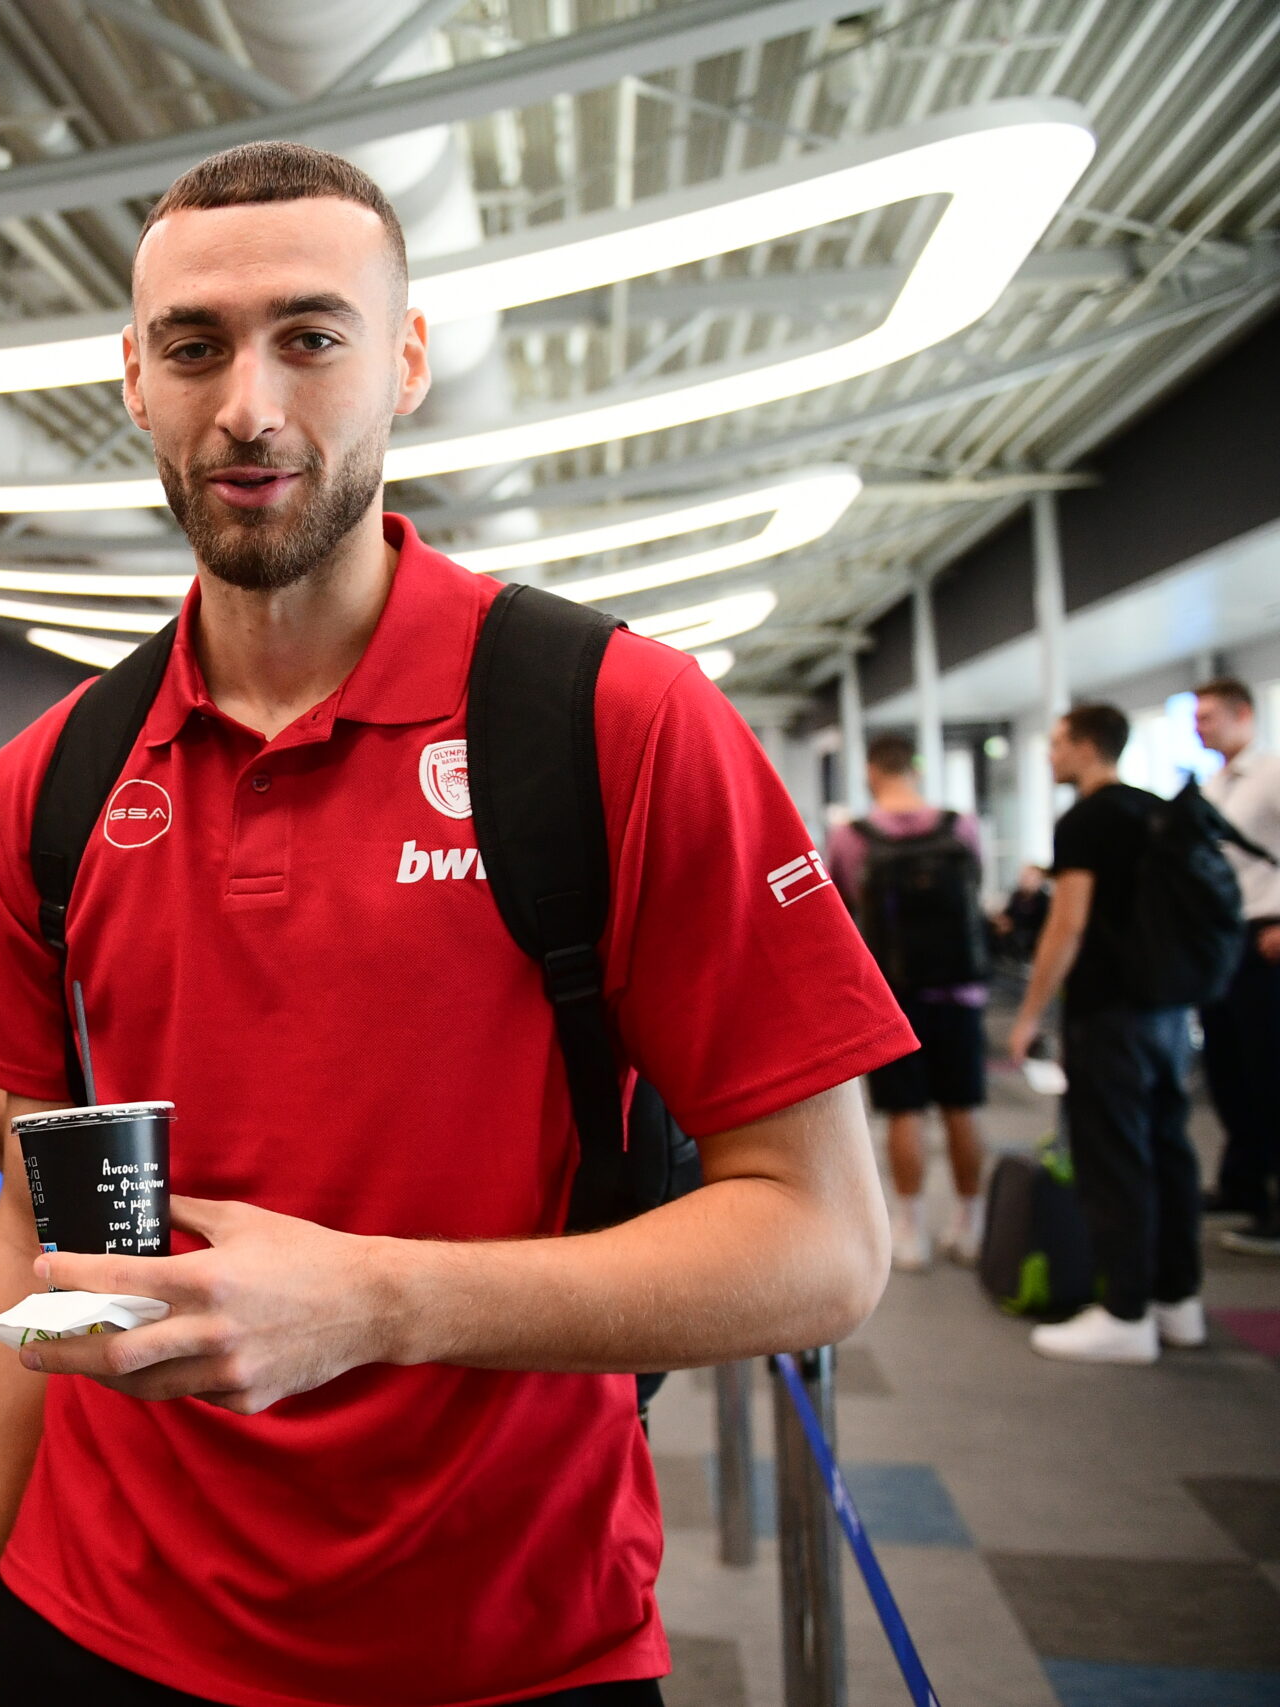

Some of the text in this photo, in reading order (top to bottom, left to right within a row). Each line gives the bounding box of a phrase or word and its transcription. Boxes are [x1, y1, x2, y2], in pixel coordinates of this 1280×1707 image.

[110, 807, 167, 820] GSA
[144, 1162, 159, 1172] που
[97, 1183, 115, 1192] σου
[113, 1195, 152, 1215] τη μέρα
[109, 1212, 160, 1235] τους ξέρεις
[122, 1238, 133, 1247] το
[137, 1234, 160, 1254] μικρό
